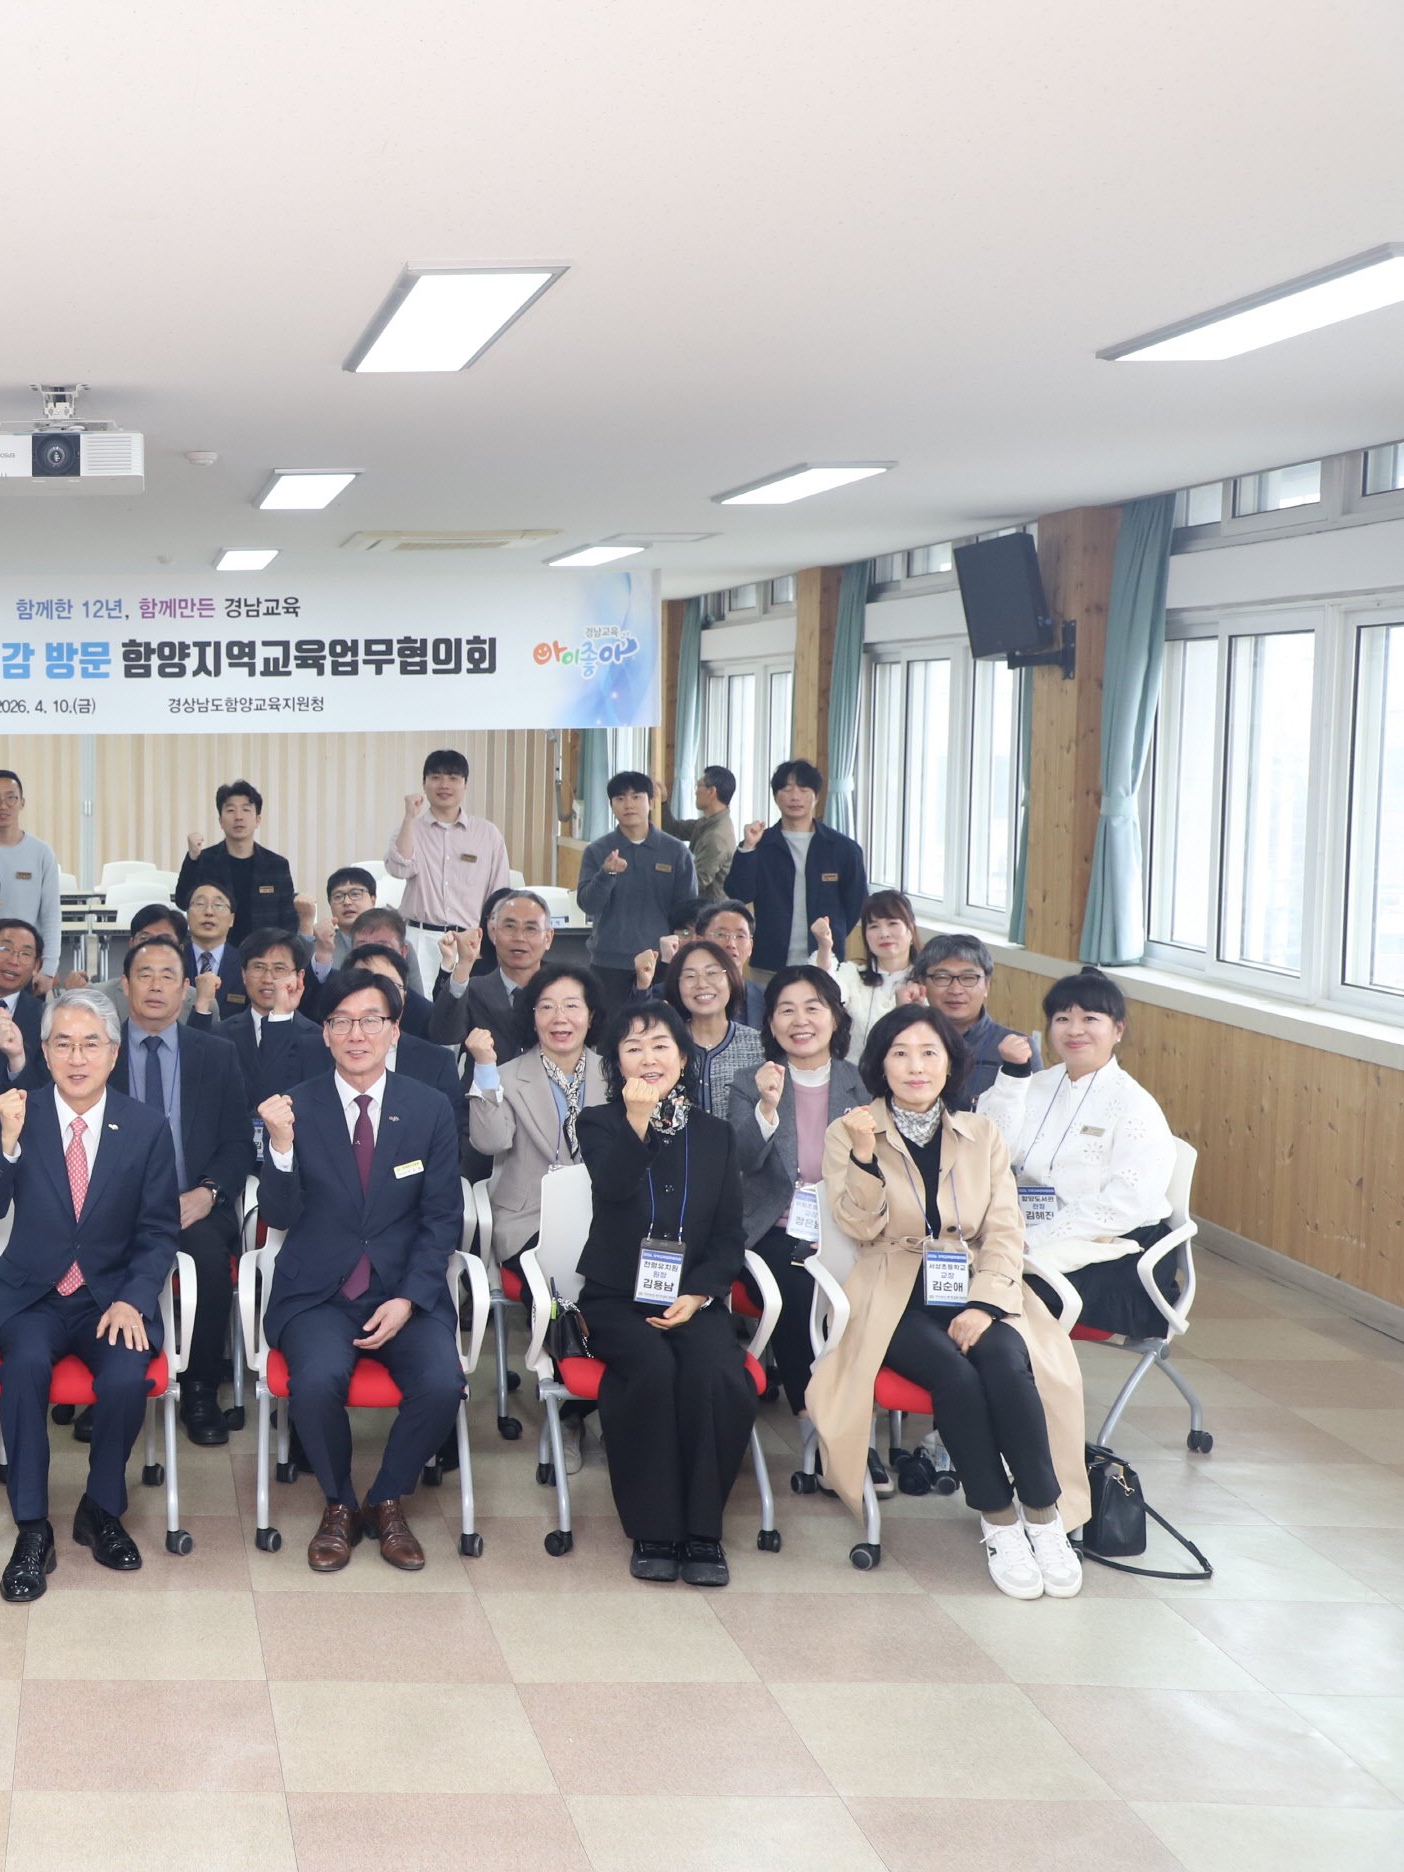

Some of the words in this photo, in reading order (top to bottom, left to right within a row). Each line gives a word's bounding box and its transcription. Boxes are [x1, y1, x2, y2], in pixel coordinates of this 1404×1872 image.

[16, 598, 73, 620] 함께한
[82, 598, 130, 620] 12년,
[139, 597, 216, 619] 함께만든
[224, 595, 302, 618] 경남교육
[585, 627, 618, 638] 경남교육
[45, 641, 112, 680] 방문
[121, 636, 498, 680] 함양지역교육업무협의회
[532, 637, 638, 678] 아이좋아
[34, 700, 47, 714] 4.
[52, 698, 97, 715] 10.(금)
[168, 696, 325, 713] 경상남도함양교육지원청
[929, 1263, 966, 1271] 서상초등학교
[643, 1279, 674, 1292] 김용남
[932, 1281, 963, 1292] 김순애
